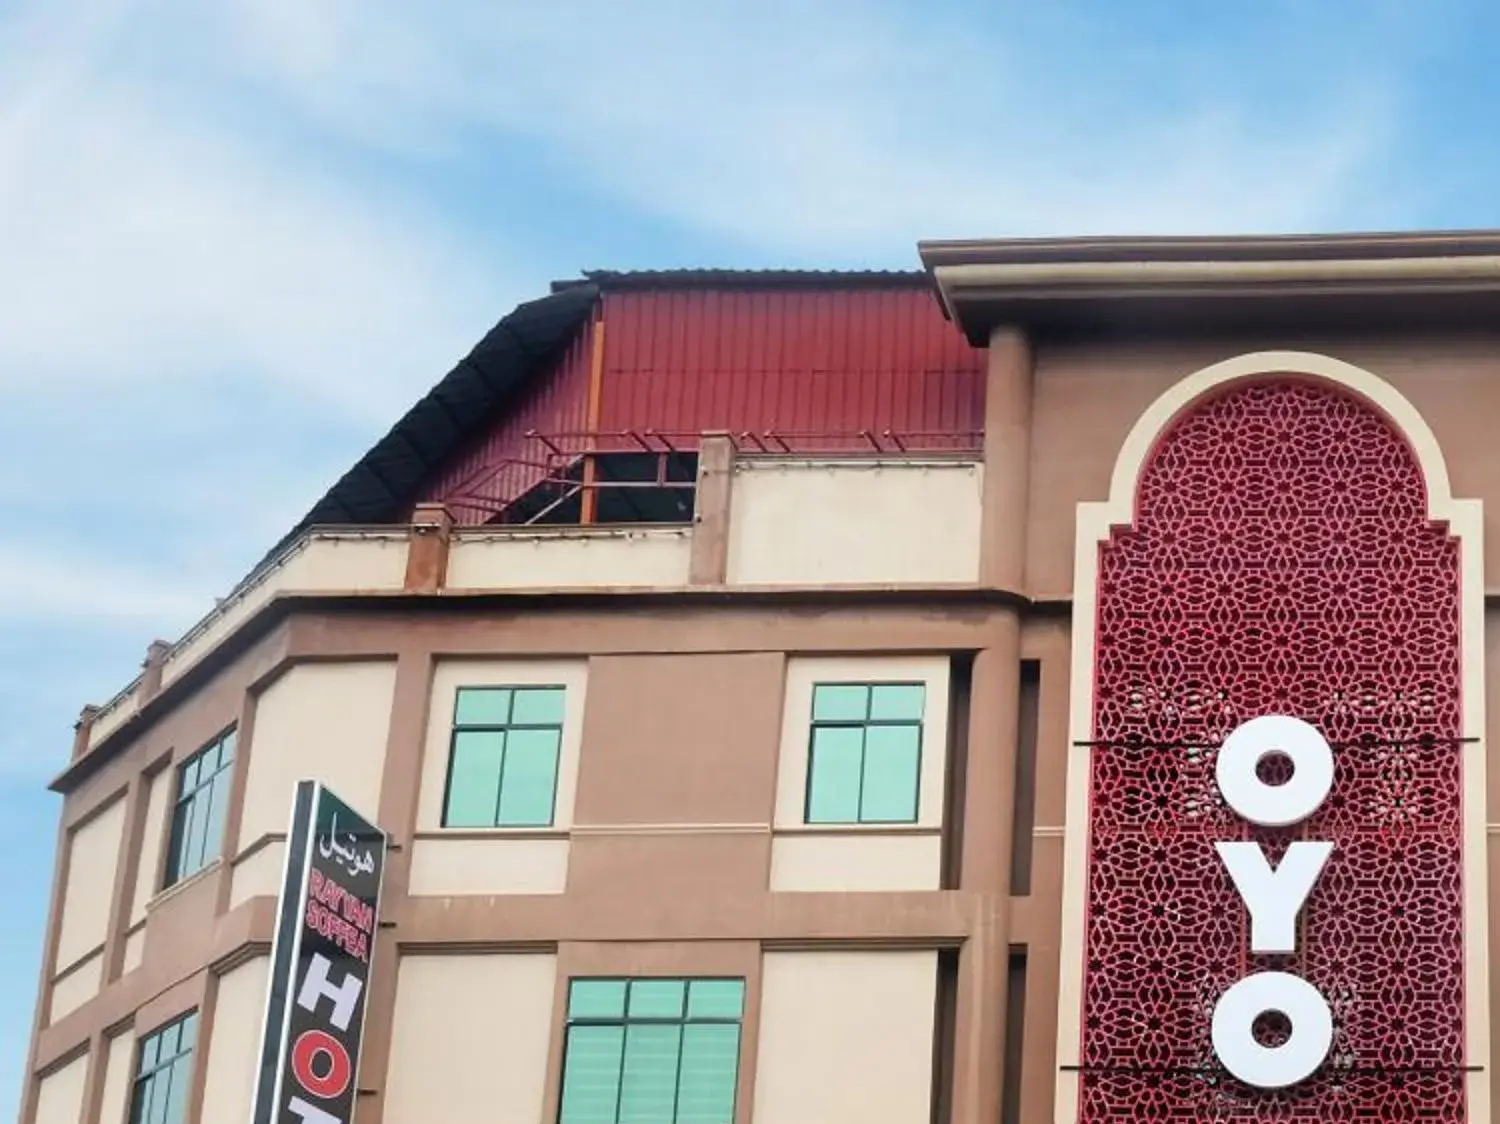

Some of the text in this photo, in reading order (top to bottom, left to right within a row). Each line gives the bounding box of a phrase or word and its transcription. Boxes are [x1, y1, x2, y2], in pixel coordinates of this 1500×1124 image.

[305, 900, 369, 964] SOFFEA
[309, 867, 373, 935] RAYYAN
[1211, 714, 1335, 1088] OYO
